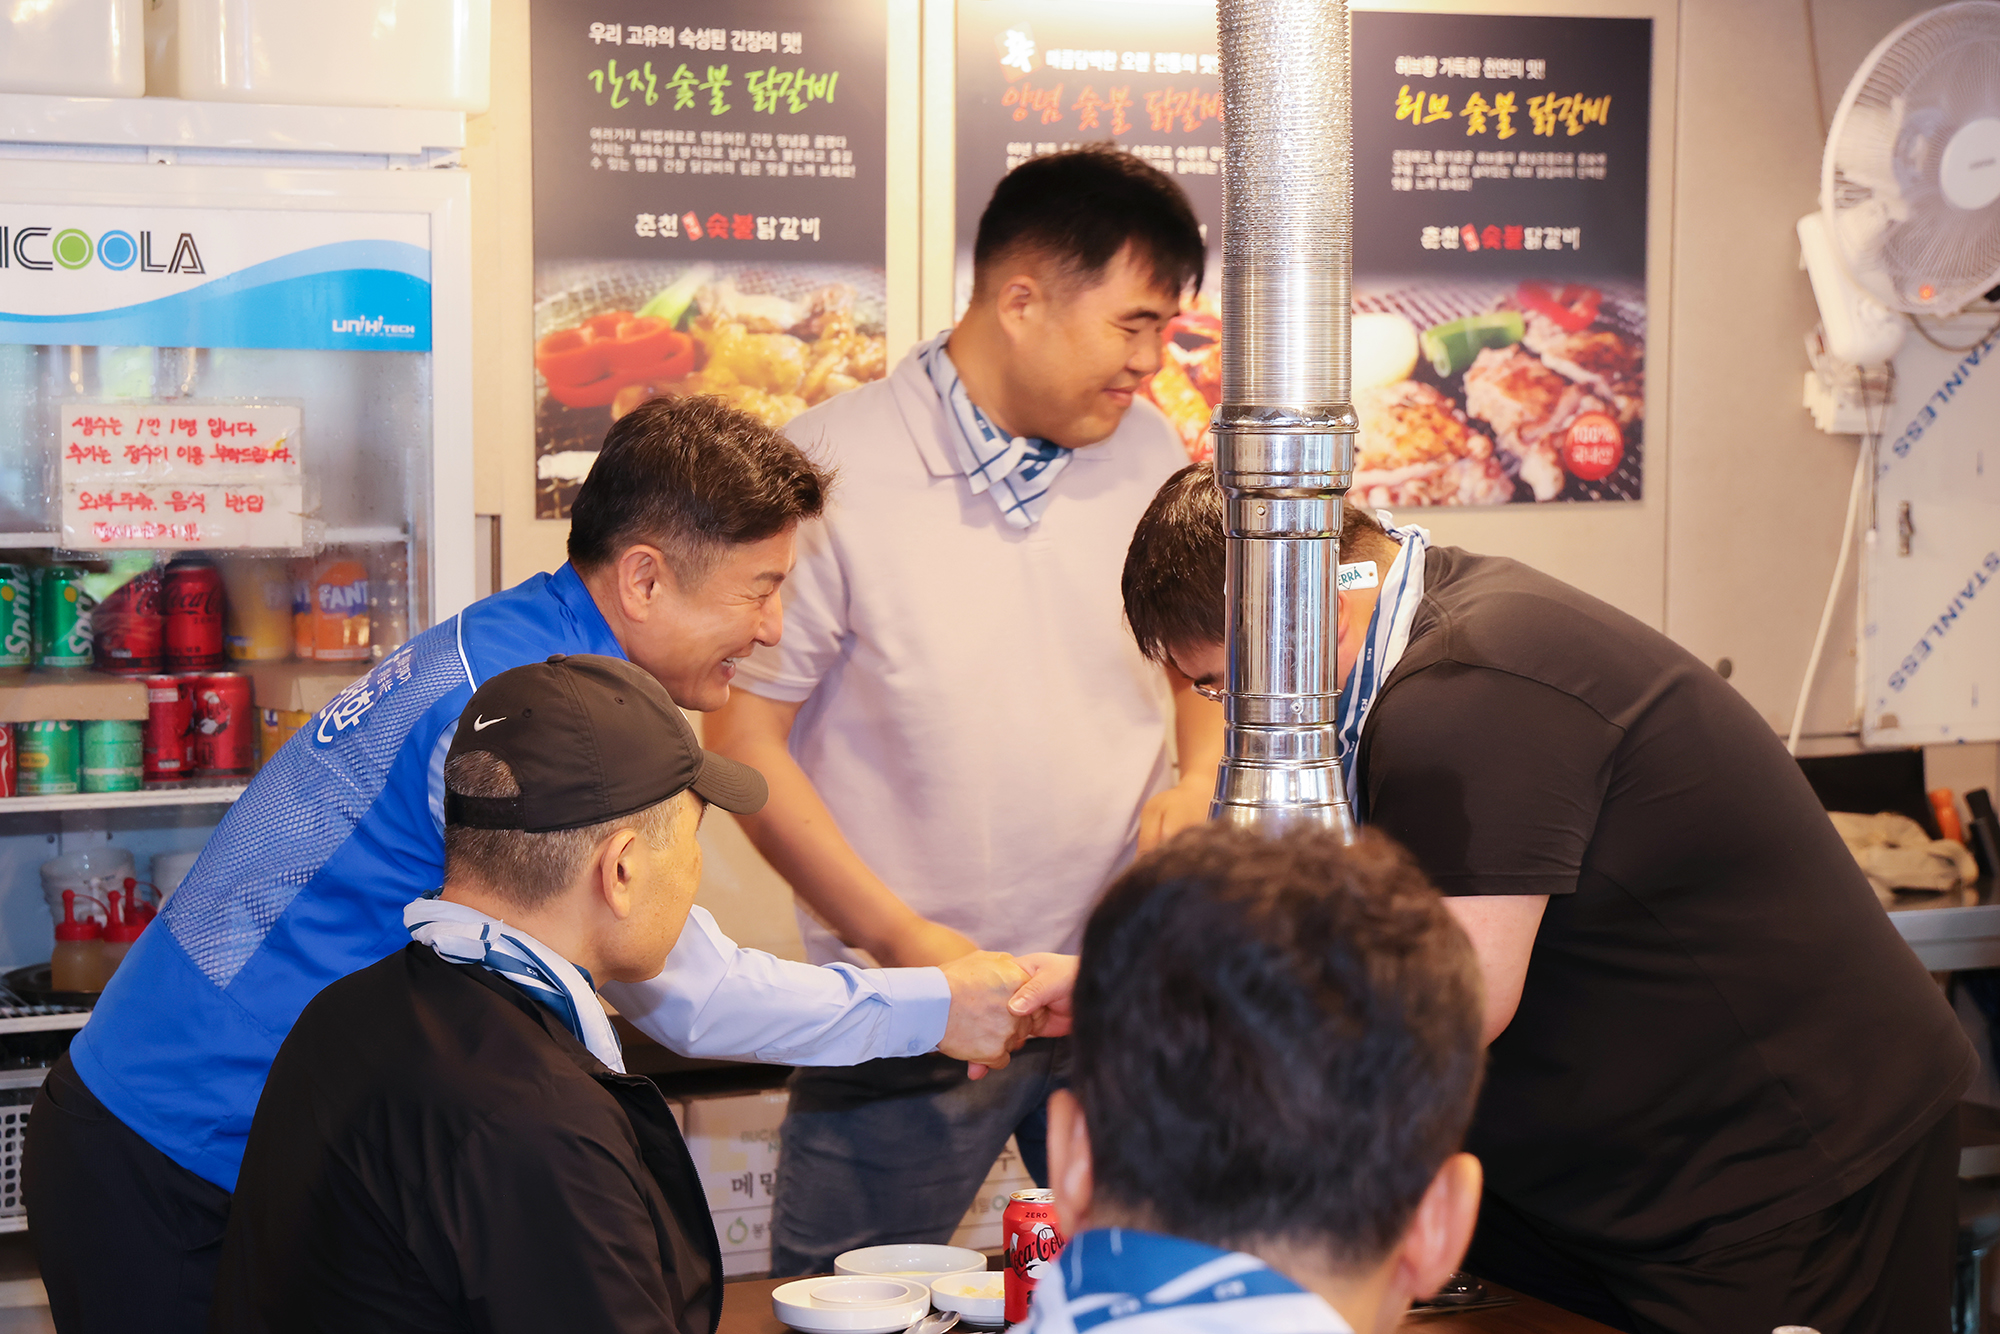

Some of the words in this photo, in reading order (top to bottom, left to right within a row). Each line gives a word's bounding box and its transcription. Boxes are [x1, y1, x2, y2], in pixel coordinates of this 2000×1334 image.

[588, 21, 622, 46] 우리
[626, 24, 675, 48] 고유의
[678, 26, 727, 50] 숙성된
[730, 29, 778, 53] 간장의
[587, 58, 659, 109] 간장
[743, 65, 840, 115] 닭갈비
[1001, 82, 1065, 125] 양념
[1394, 84, 1454, 126] 허브
[1526, 91, 1613, 137] 닭갈비
[634, 212, 679, 238] 춘천
[1420, 225, 1460, 250] 춘천
[1891, 331, 2000, 460] TAINLESS
[71, 416, 123, 437] 생수는
[170, 418, 198, 438] 1병
[207, 417, 258, 438] 입니다
[65, 442, 112, 465] 추가는
[123, 444, 169, 464] 정수기
[176, 445, 205, 466] 이용
[1570, 444, 1615, 466] 국내산
[163, 491, 206, 513] 음식
[224, 491, 265, 513] 반입
[1887, 551, 2000, 693] STAINLESS
